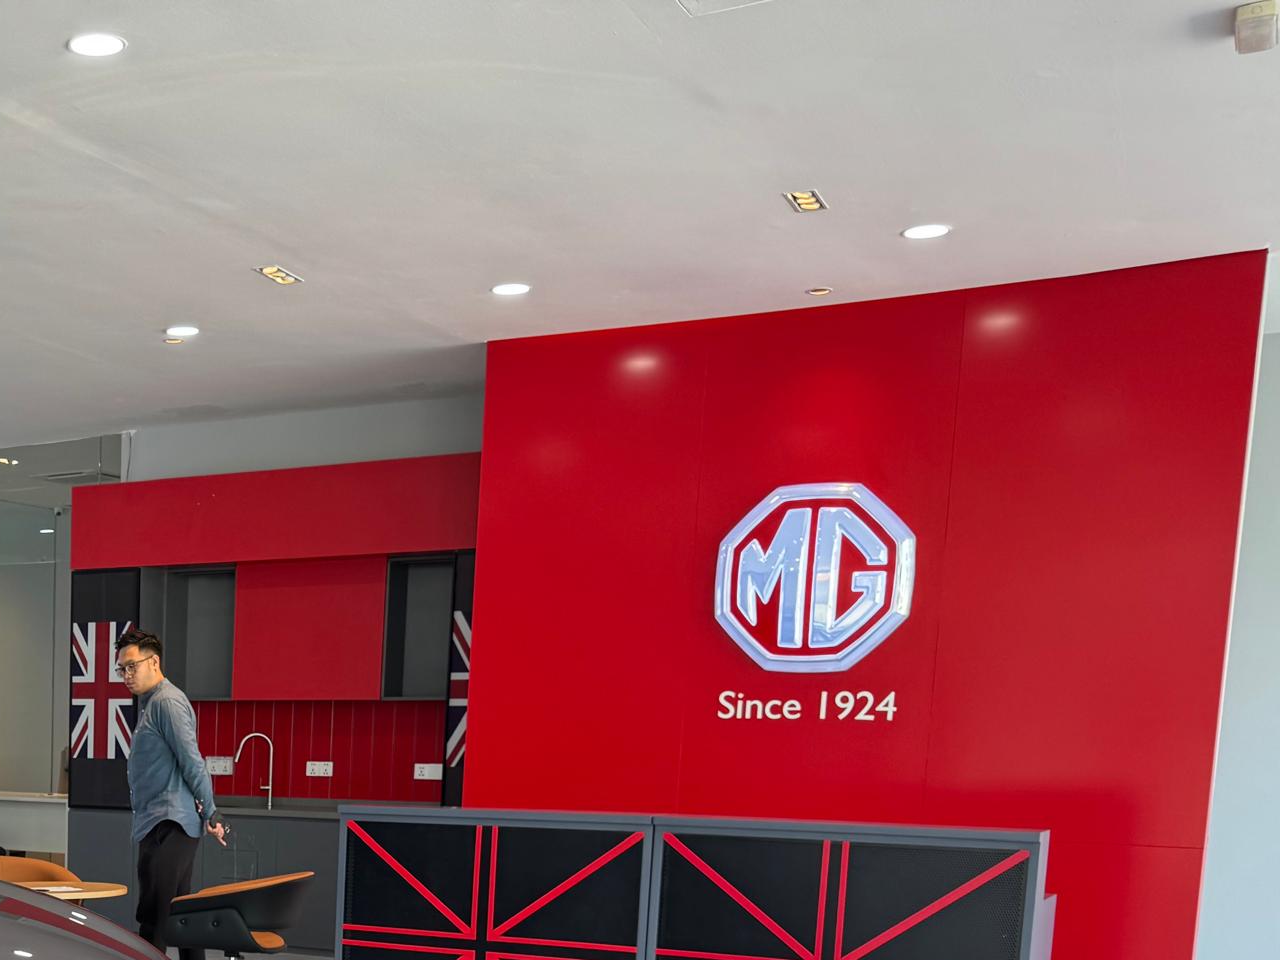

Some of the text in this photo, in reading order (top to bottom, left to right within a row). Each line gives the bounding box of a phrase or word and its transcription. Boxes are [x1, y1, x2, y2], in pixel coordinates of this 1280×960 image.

[735, 505, 889, 650] MG
[717, 690, 898, 721] Since 1924
